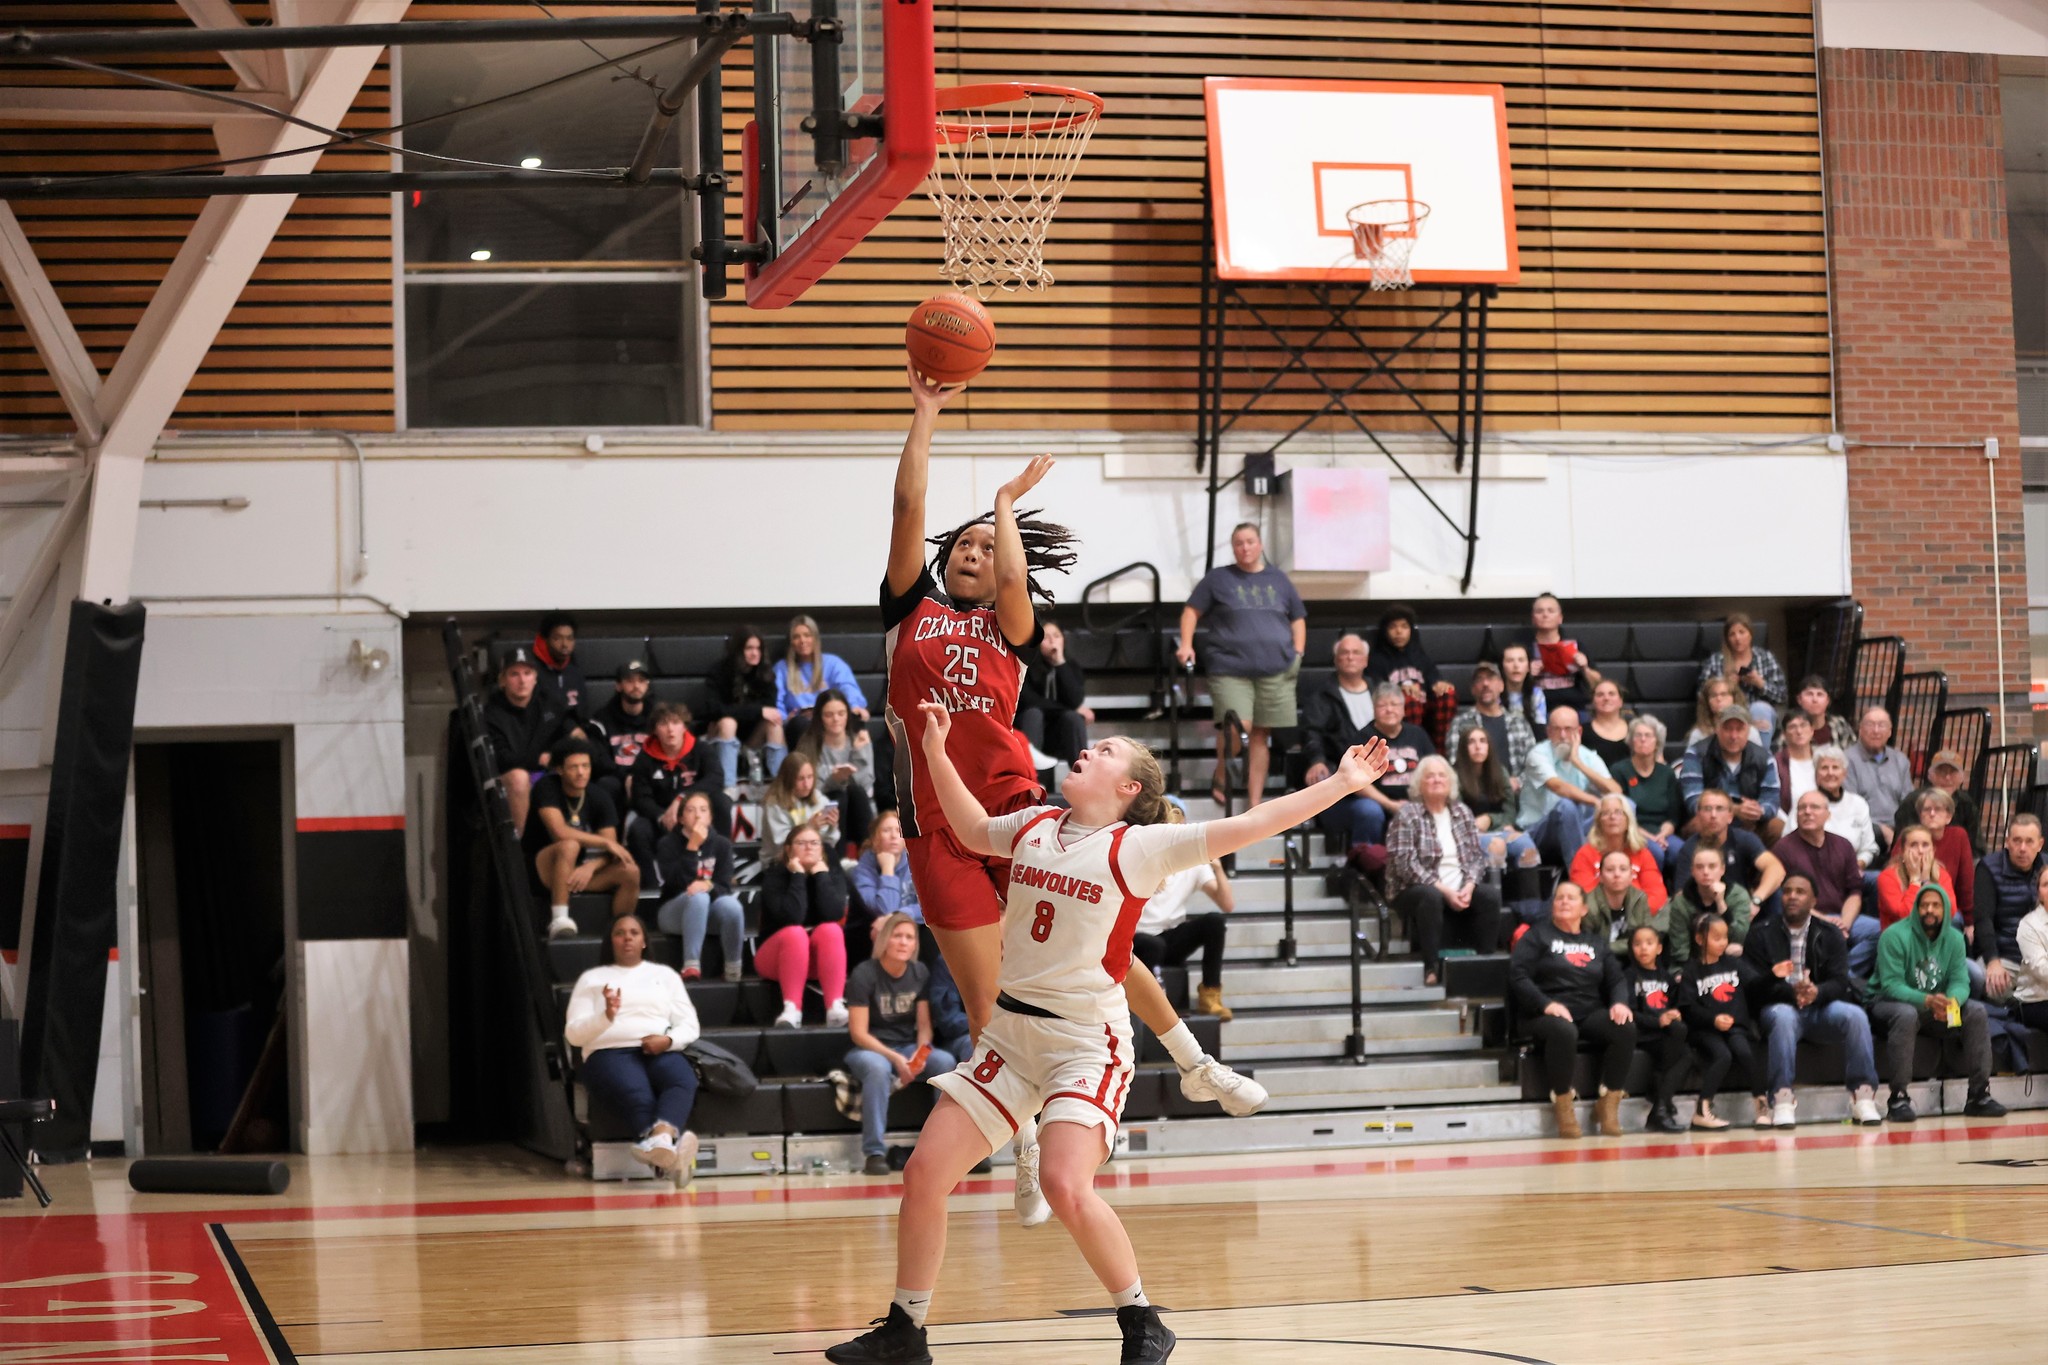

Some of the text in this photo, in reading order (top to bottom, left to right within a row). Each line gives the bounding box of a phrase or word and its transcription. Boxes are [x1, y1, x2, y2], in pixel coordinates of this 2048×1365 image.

[914, 614, 1008, 658] CENTRAL
[943, 643, 980, 687] 25
[929, 686, 995, 714] MANE
[1011, 863, 1104, 905] SEAWOLVES
[1030, 899, 1056, 944] 8
[973, 1049, 1006, 1084] 8
